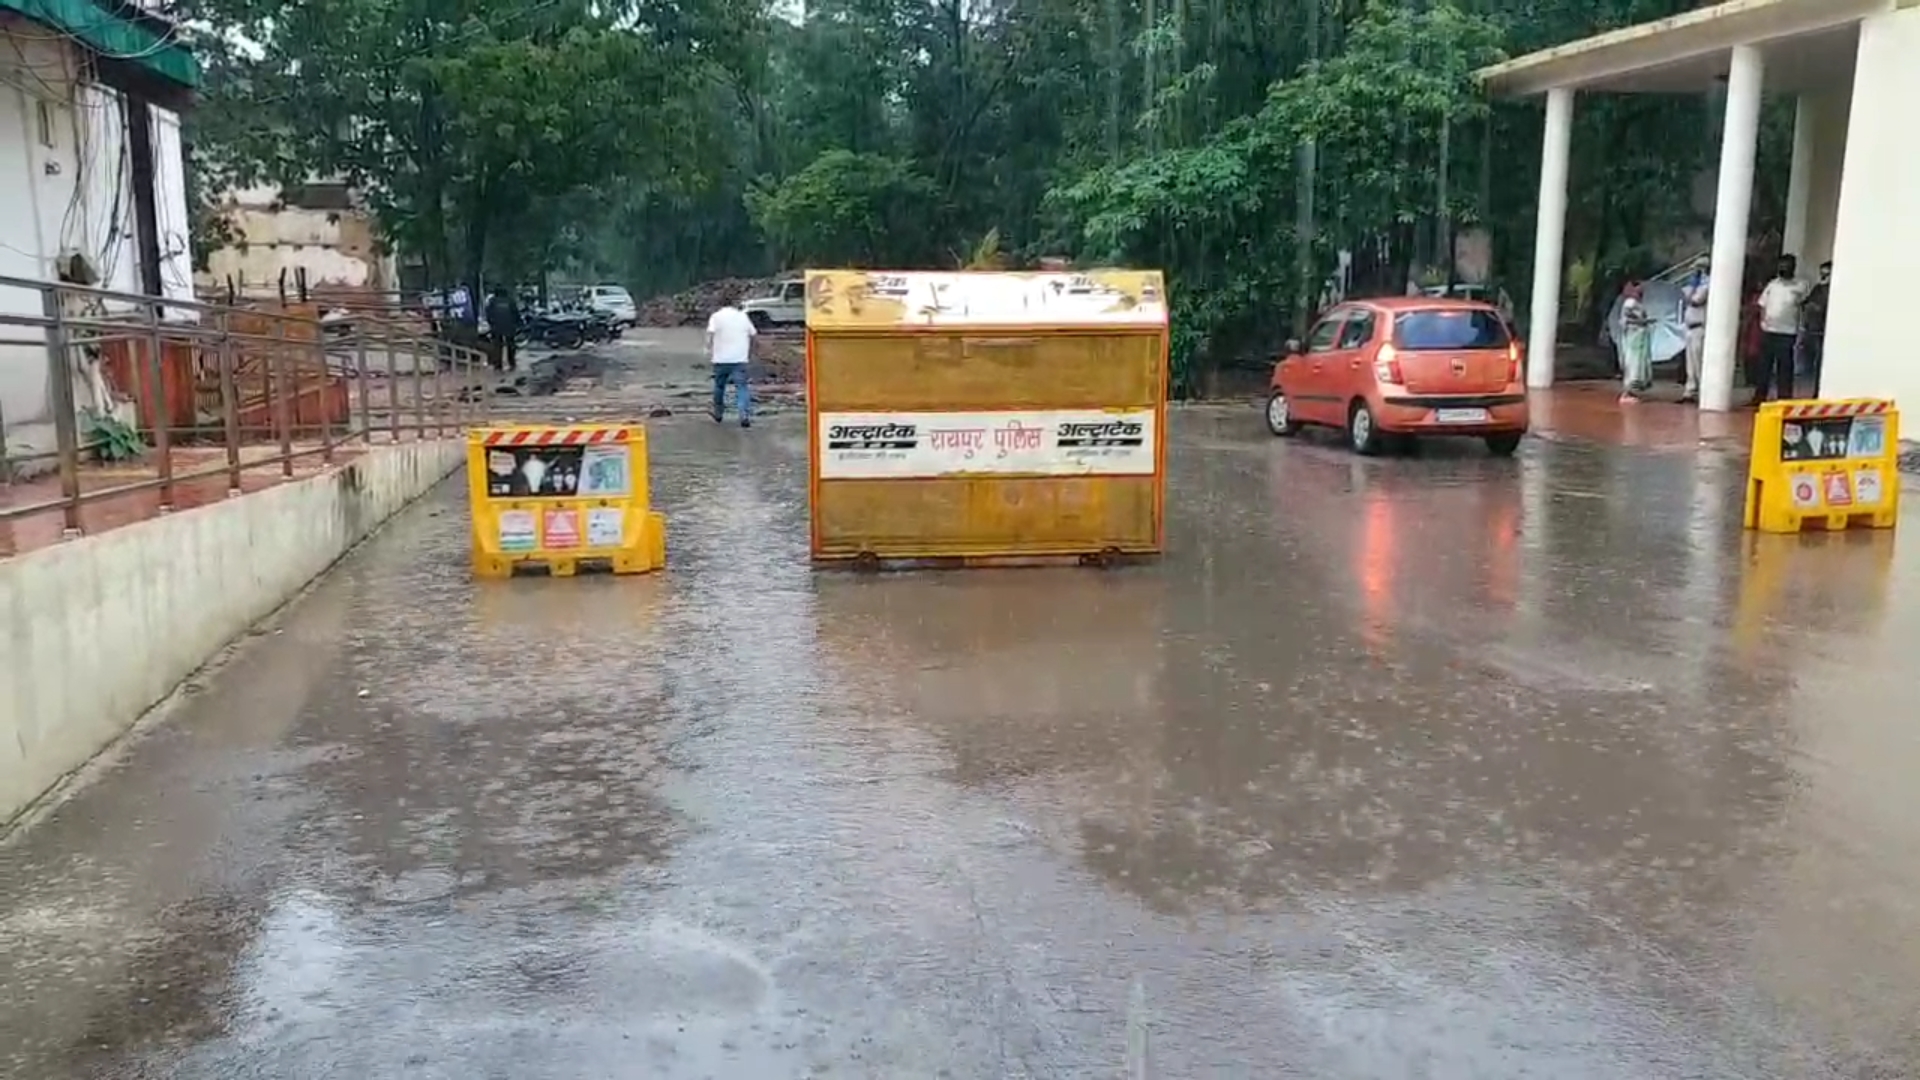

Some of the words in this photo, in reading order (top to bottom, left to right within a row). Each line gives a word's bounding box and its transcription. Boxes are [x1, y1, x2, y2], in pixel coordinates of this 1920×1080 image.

[829, 422, 916, 440] अल्ट्राटेक
[928, 428, 985, 459] रायपुर
[994, 419, 1044, 459] पुलिस
[1057, 421, 1143, 438] अल्ट्राटेक
